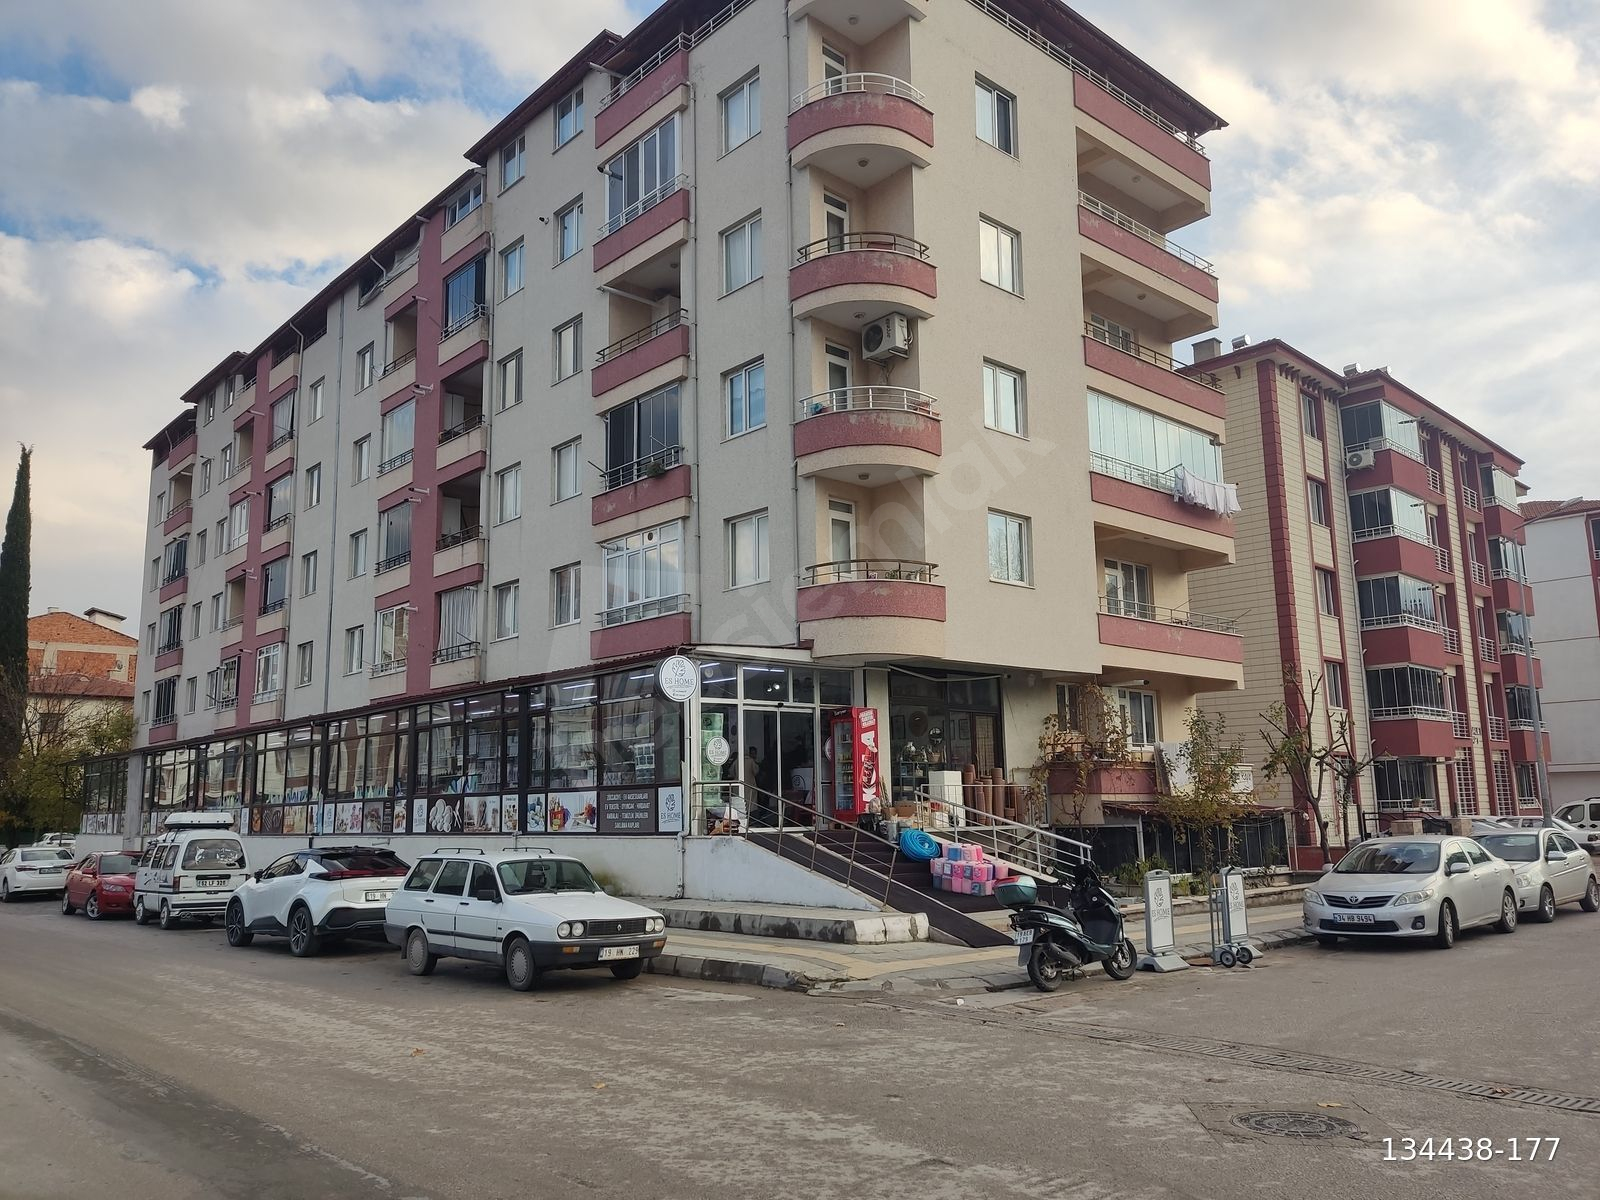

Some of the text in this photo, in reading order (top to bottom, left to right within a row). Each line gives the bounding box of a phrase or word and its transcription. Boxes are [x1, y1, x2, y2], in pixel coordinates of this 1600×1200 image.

[674, 678, 694, 686] HOME
[1157, 908, 1170, 917] HOME
[1338, 914, 1346, 922] 34
[605, 948, 612, 957] 19
